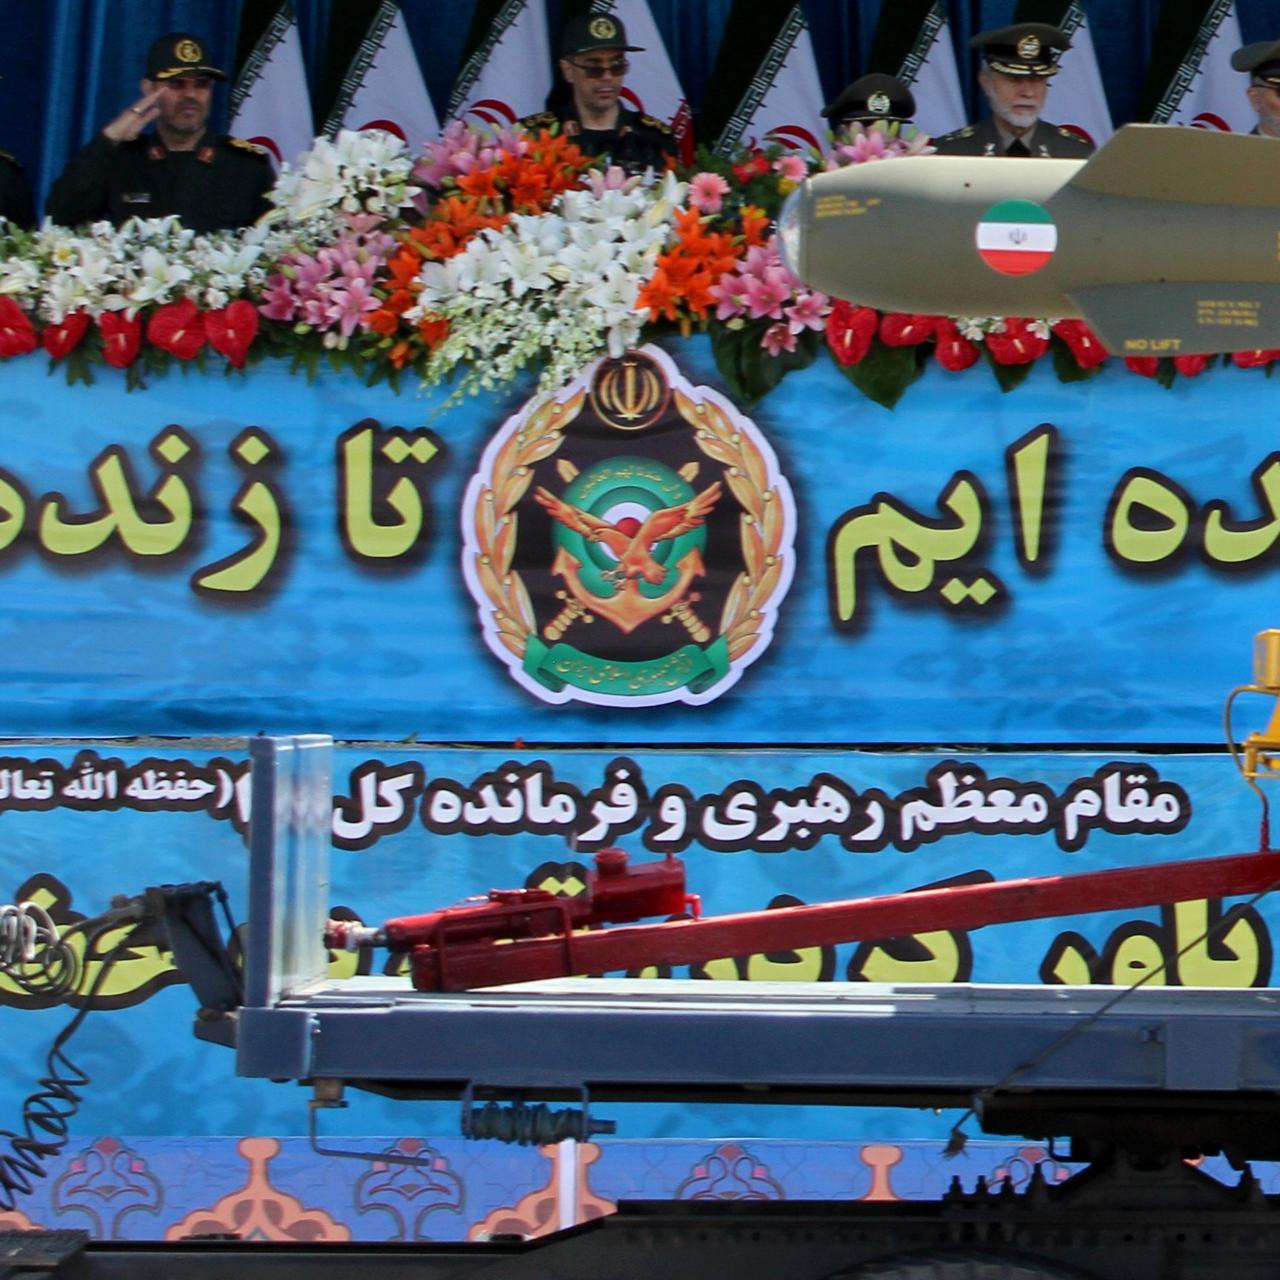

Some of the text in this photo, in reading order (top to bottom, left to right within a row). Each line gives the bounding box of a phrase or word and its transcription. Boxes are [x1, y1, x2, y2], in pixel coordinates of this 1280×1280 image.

[1124, 339, 1182, 351] NO LIFT
[344, 427, 439, 558] تا
[833, 431, 1054, 623] ایم
[430, 767, 638, 841] فرمانده
[652, 796, 686, 841] و
[701, 781, 883, 841] رهبری
[902, 766, 1048, 841] معظم
[1063, 771, 1181, 841] مقام
